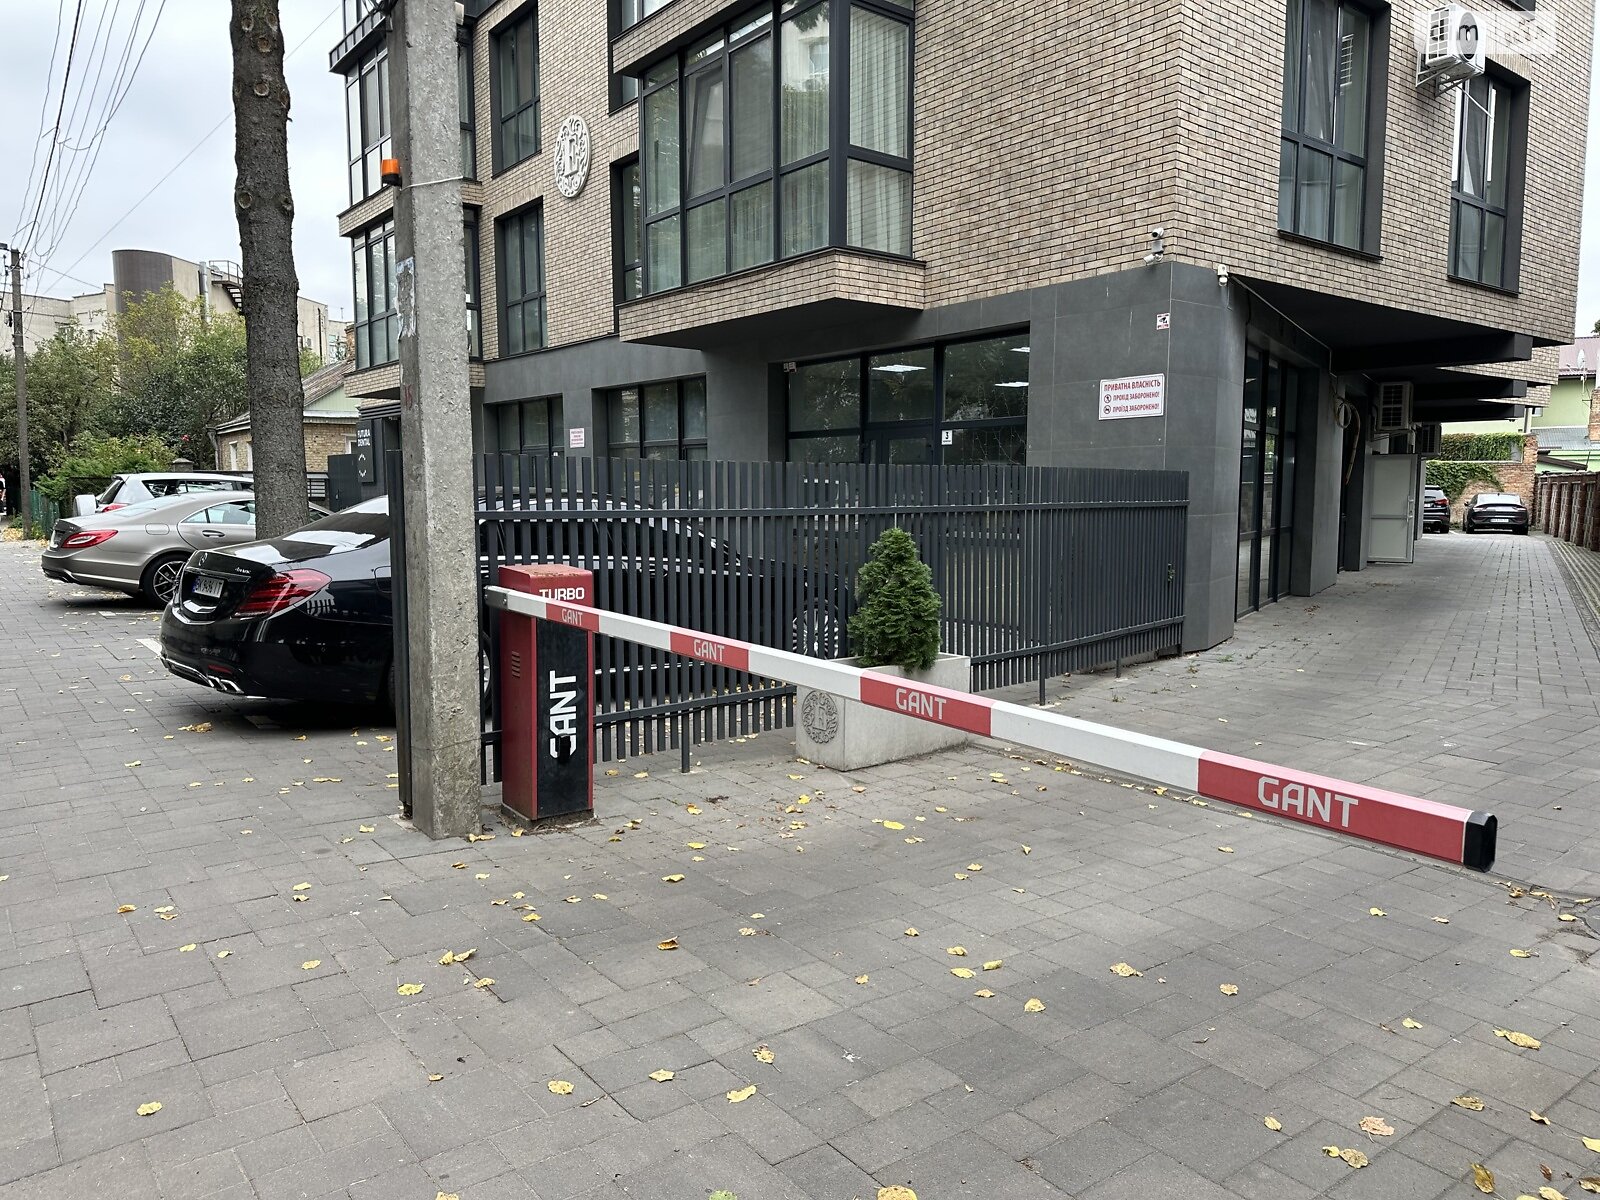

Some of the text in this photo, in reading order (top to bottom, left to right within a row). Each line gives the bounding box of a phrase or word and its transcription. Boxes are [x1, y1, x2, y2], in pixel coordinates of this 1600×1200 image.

[1103, 379, 1161, 391] ПРИВАТНА ВЛАСНІСТЬ
[1129, 392, 1160, 400] ЗАБОРОНЕНО!
[1113, 403, 1160, 412] ПРОЇЗД ЗАБОРОНЕНО!
[357, 429, 371, 438] FUTURA
[357, 438, 371, 447] DENTAL
[539, 587, 585, 601] TURBO
[561, 608, 583, 627] GANT
[693, 639, 725, 662] GANT
[895, 687, 947, 720] GANT
[549, 670, 577, 759] GANT
[1257, 776, 1359, 828] GANT
